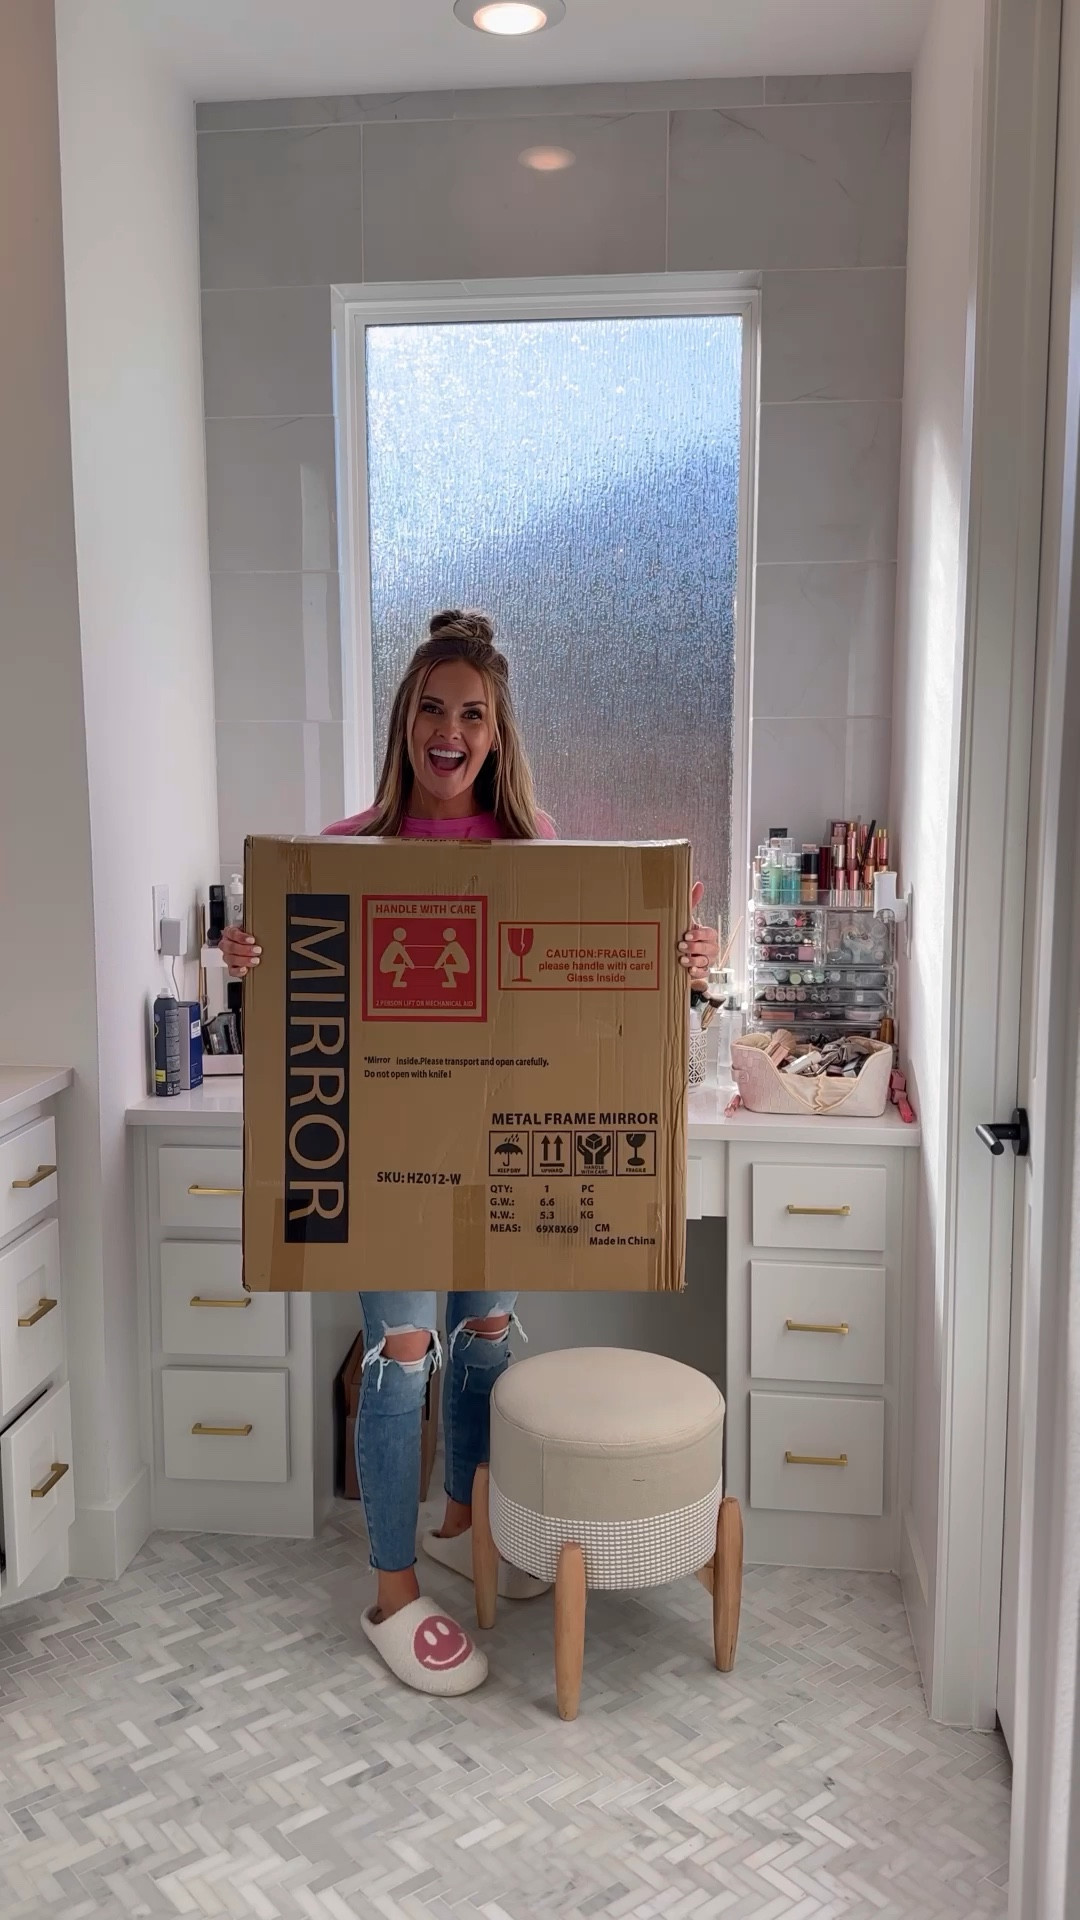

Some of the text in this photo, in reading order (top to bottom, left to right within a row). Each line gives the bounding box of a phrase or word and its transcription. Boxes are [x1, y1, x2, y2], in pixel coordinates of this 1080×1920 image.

[376, 904, 476, 914] HANDLE WITH CARE
[539, 961, 653, 972] please handle with care!
[567, 973, 594, 982] Glass
[444, 1058, 479, 1067] transport
[480, 1057, 494, 1066] and
[496, 1058, 514, 1067] open
[516, 1057, 549, 1067] carefully.
[288, 916, 346, 1221] MIRROR
[364, 1070, 375, 1078] Do
[390, 1070, 410, 1080] open
[411, 1070, 427, 1078] with
[492, 1112, 658, 1124] METAL FRAME MIRROR
[376, 1172, 462, 1184] SKU: HZ012-W
[490, 1184, 512, 1193] QTY:
[582, 1184, 594, 1192] PC
[490, 1198, 594, 1206] G.W.: 6.6 KG
[490, 1211, 594, 1220] N.W.: 5.3 KG
[490, 1224, 521, 1232] MEAS:
[594, 1224, 610, 1232] CM
[589, 1236, 616, 1246] Made
[628, 1236, 656, 1246] China
